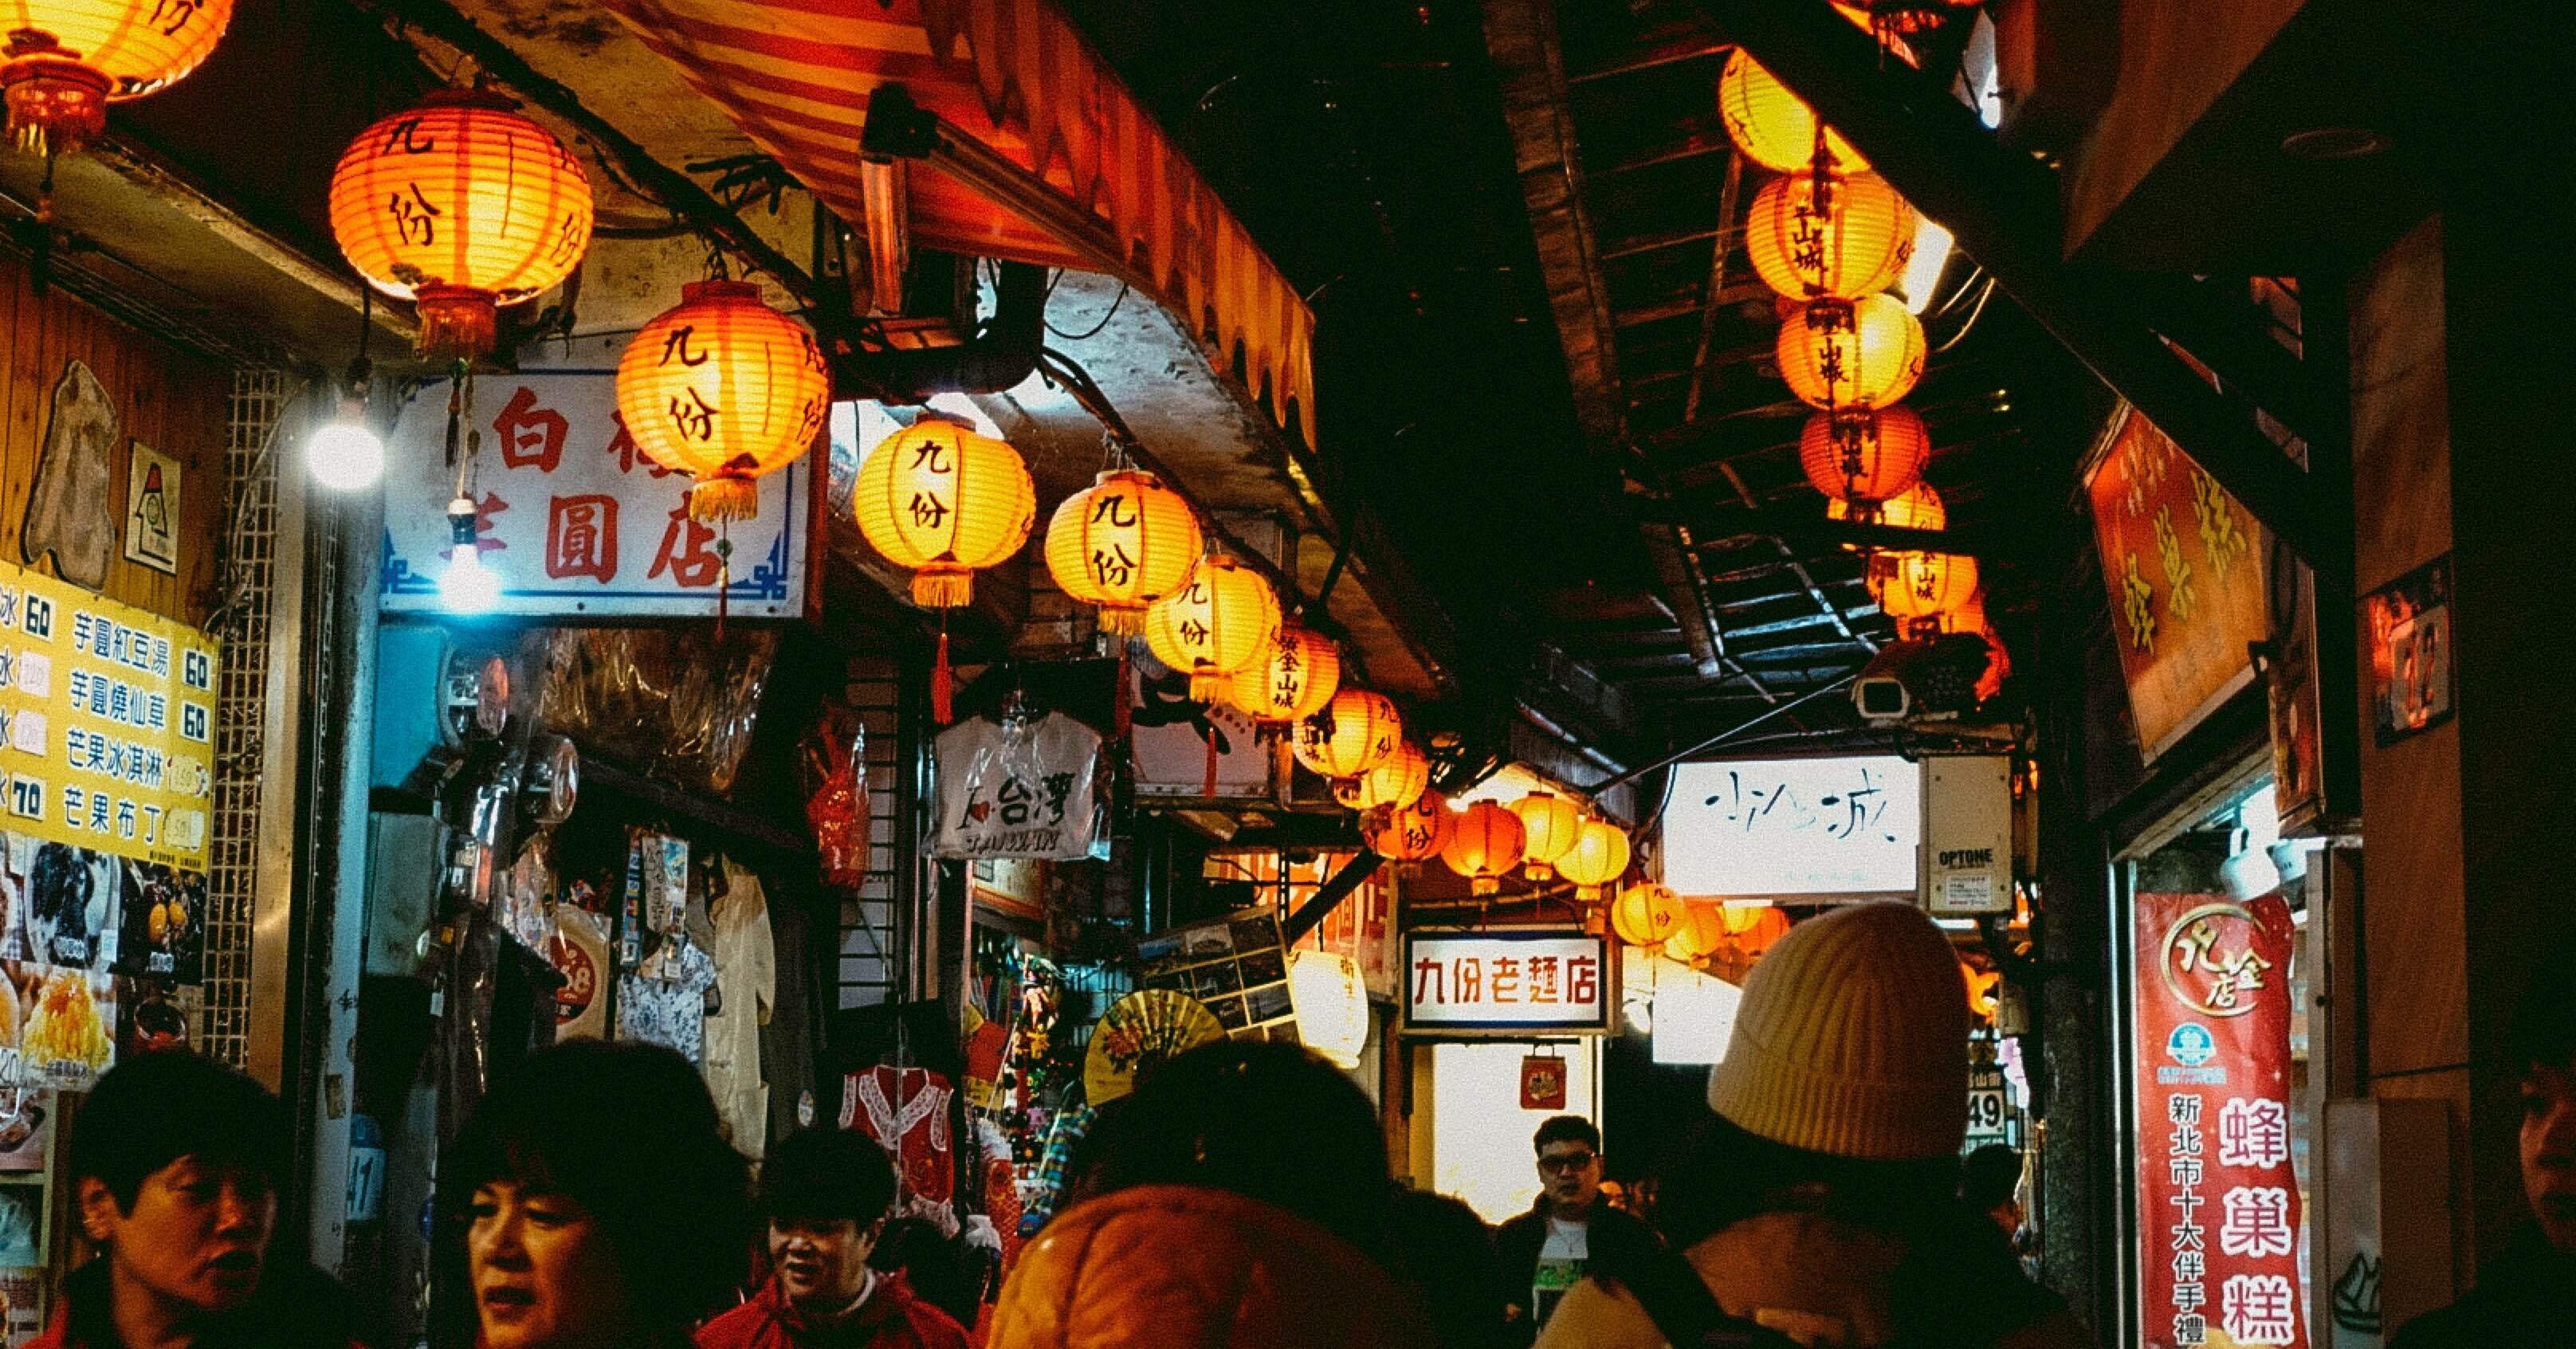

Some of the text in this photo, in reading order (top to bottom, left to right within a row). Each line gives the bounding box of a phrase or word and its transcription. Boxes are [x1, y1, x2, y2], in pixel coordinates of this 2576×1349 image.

[386, 119, 440, 247] 九份
[659, 325, 720, 442] 九份
[909, 440, 952, 529] 九份
[1092, 495, 1136, 588] 九份
[26, 594, 49, 637] 60
[1176, 583, 1210, 646] 九份
[75, 612, 168, 676] 芋圓紅豆湯
[186, 649, 207, 689] 60
[71, 671, 165, 730] 芋圓燒仙草
[184, 703, 206, 739] 60
[68, 728, 163, 787] 芒果冰淇淋
[12, 780, 40, 816] 70
[65, 786, 161, 843] 芒果布丁
[998, 772, 1076, 826] 台灣
[1415, 956, 1596, 1004] 九份老麵店
[1969, 1093, 2001, 1127] 49
[2170, 1096, 2205, 1343] 新北市十大伴手禮
[2223, 1103, 2290, 1342] 蜂巢糕
